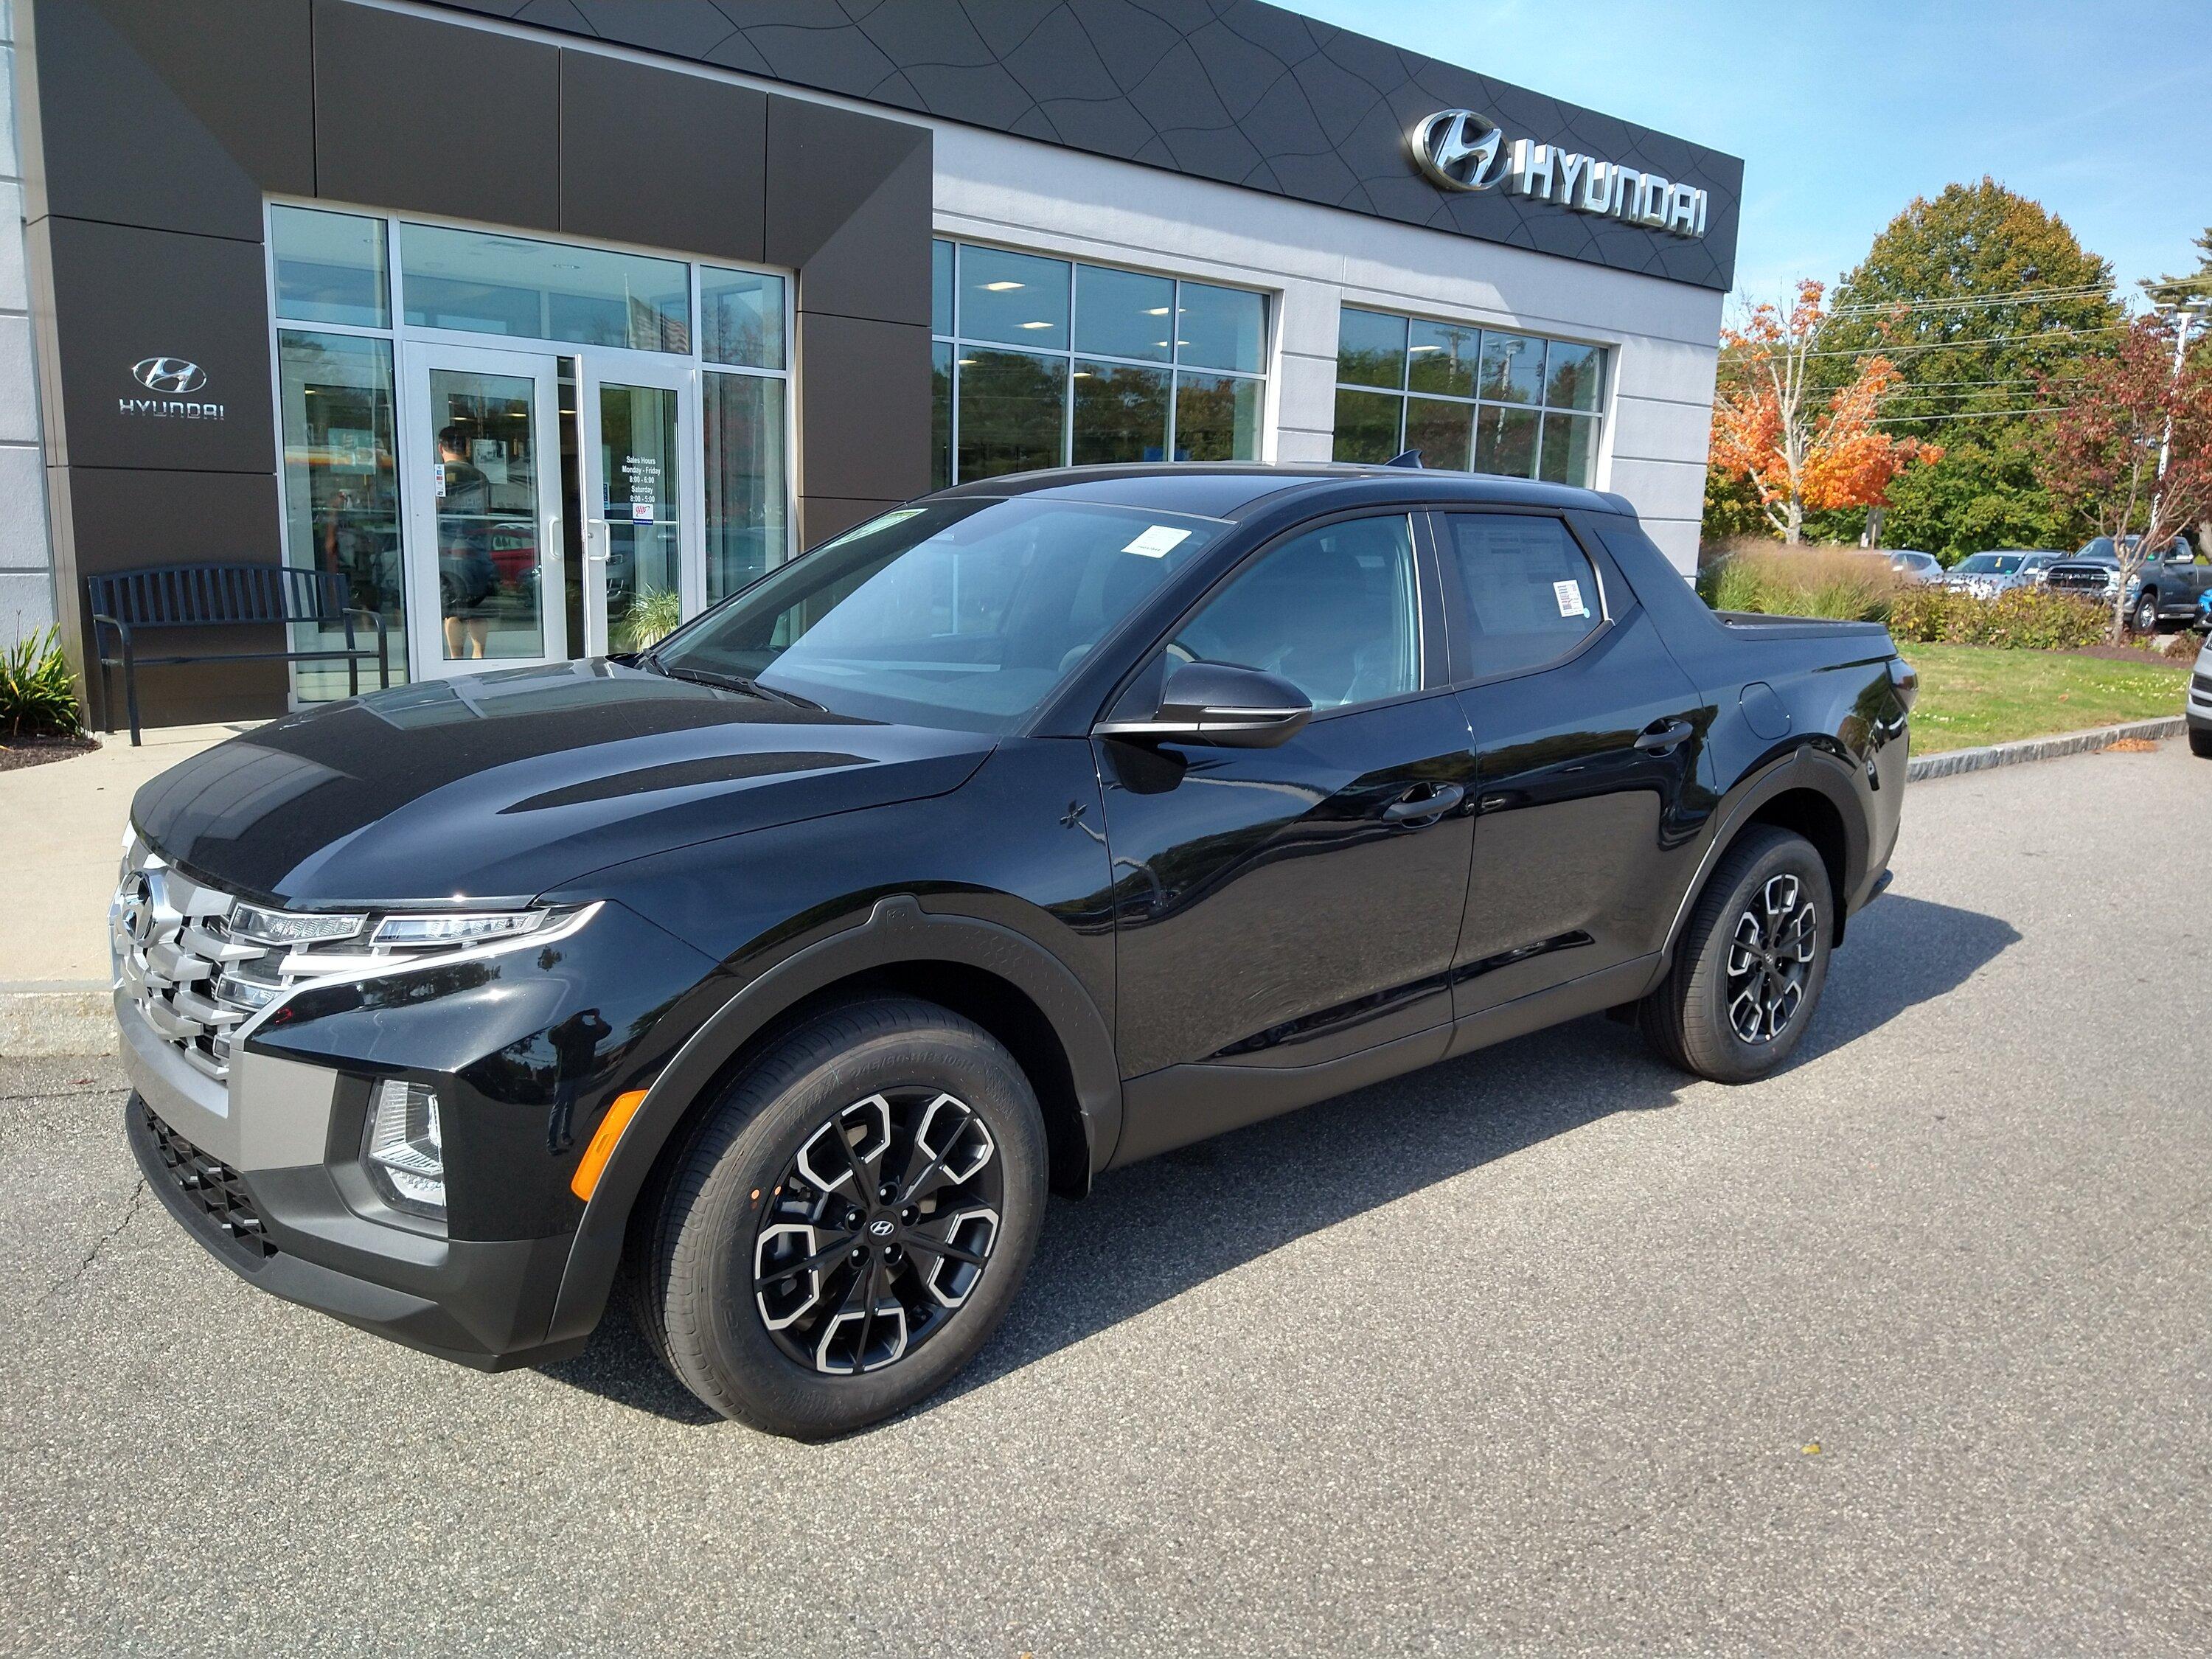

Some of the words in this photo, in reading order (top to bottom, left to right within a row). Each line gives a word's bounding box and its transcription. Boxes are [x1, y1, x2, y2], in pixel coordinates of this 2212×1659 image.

[1512, 138, 1708, 238] HYUNDAI
[119, 398, 224, 421] HYUNDAI
[626, 456, 640, 464] Sales
[622, 465, 641, 475] Monday
[645, 467, 661, 476] Friday
[631, 485, 653, 495] Saturday
